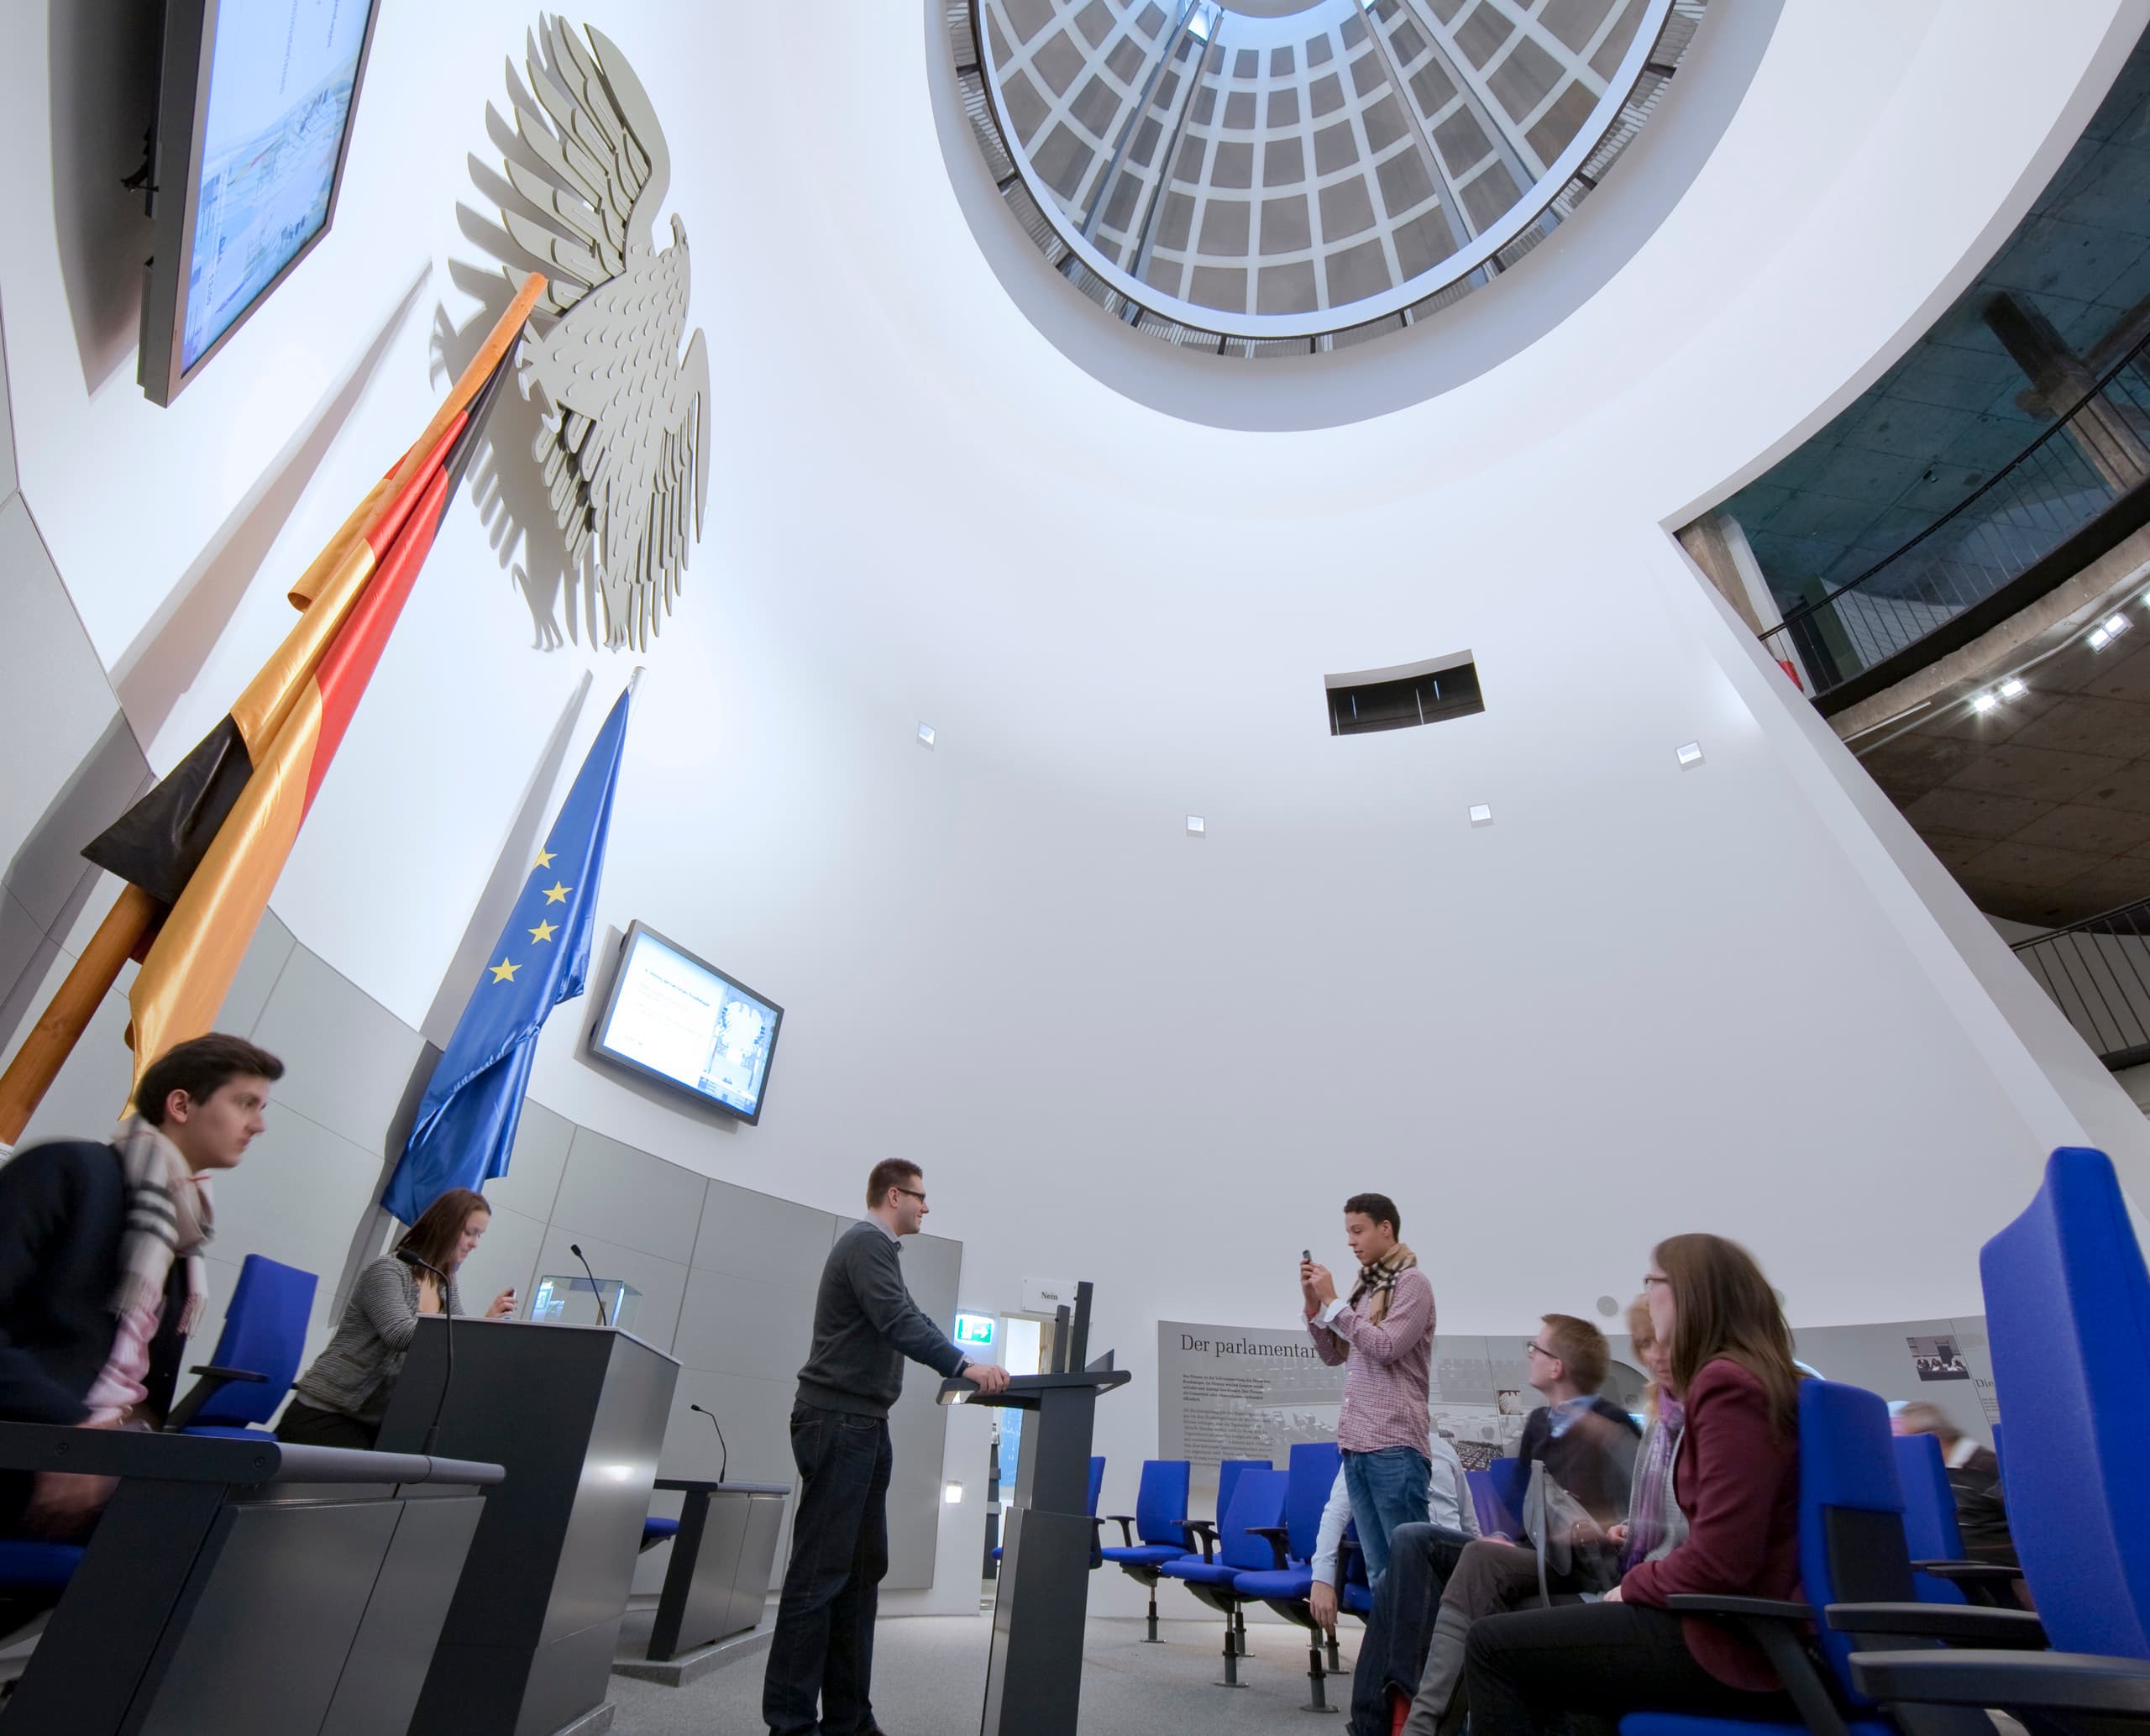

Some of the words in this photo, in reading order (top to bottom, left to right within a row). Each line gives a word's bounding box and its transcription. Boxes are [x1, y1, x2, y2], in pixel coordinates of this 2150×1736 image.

[1041, 1291, 1058, 1301] Nein
[1181, 1335, 1210, 1352] Der
[1975, 1378, 1994, 1388] Die
